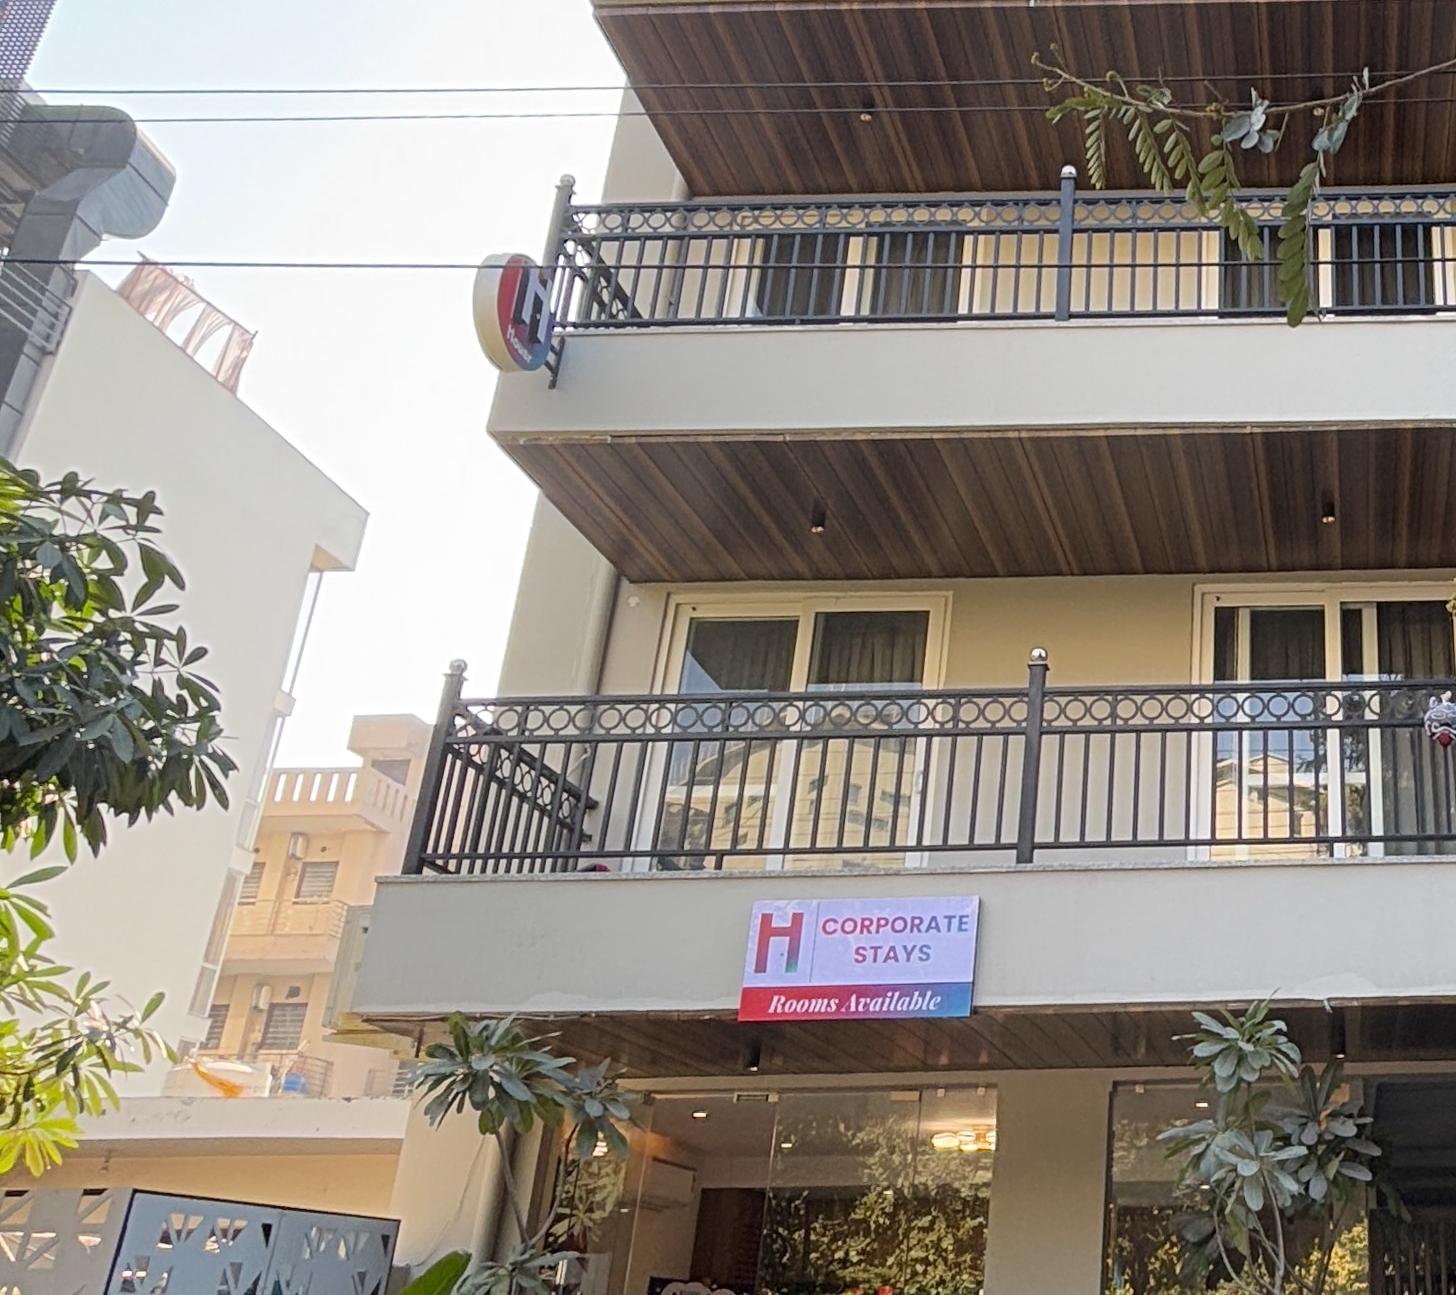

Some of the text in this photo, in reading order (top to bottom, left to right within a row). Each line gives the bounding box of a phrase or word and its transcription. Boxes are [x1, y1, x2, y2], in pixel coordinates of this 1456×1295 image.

[821, 914, 970, 935] CORPORATE
[754, 912, 804, 973] H
[854, 944, 932, 964] STAYS
[767, 990, 942, 1014] Rooms Available
